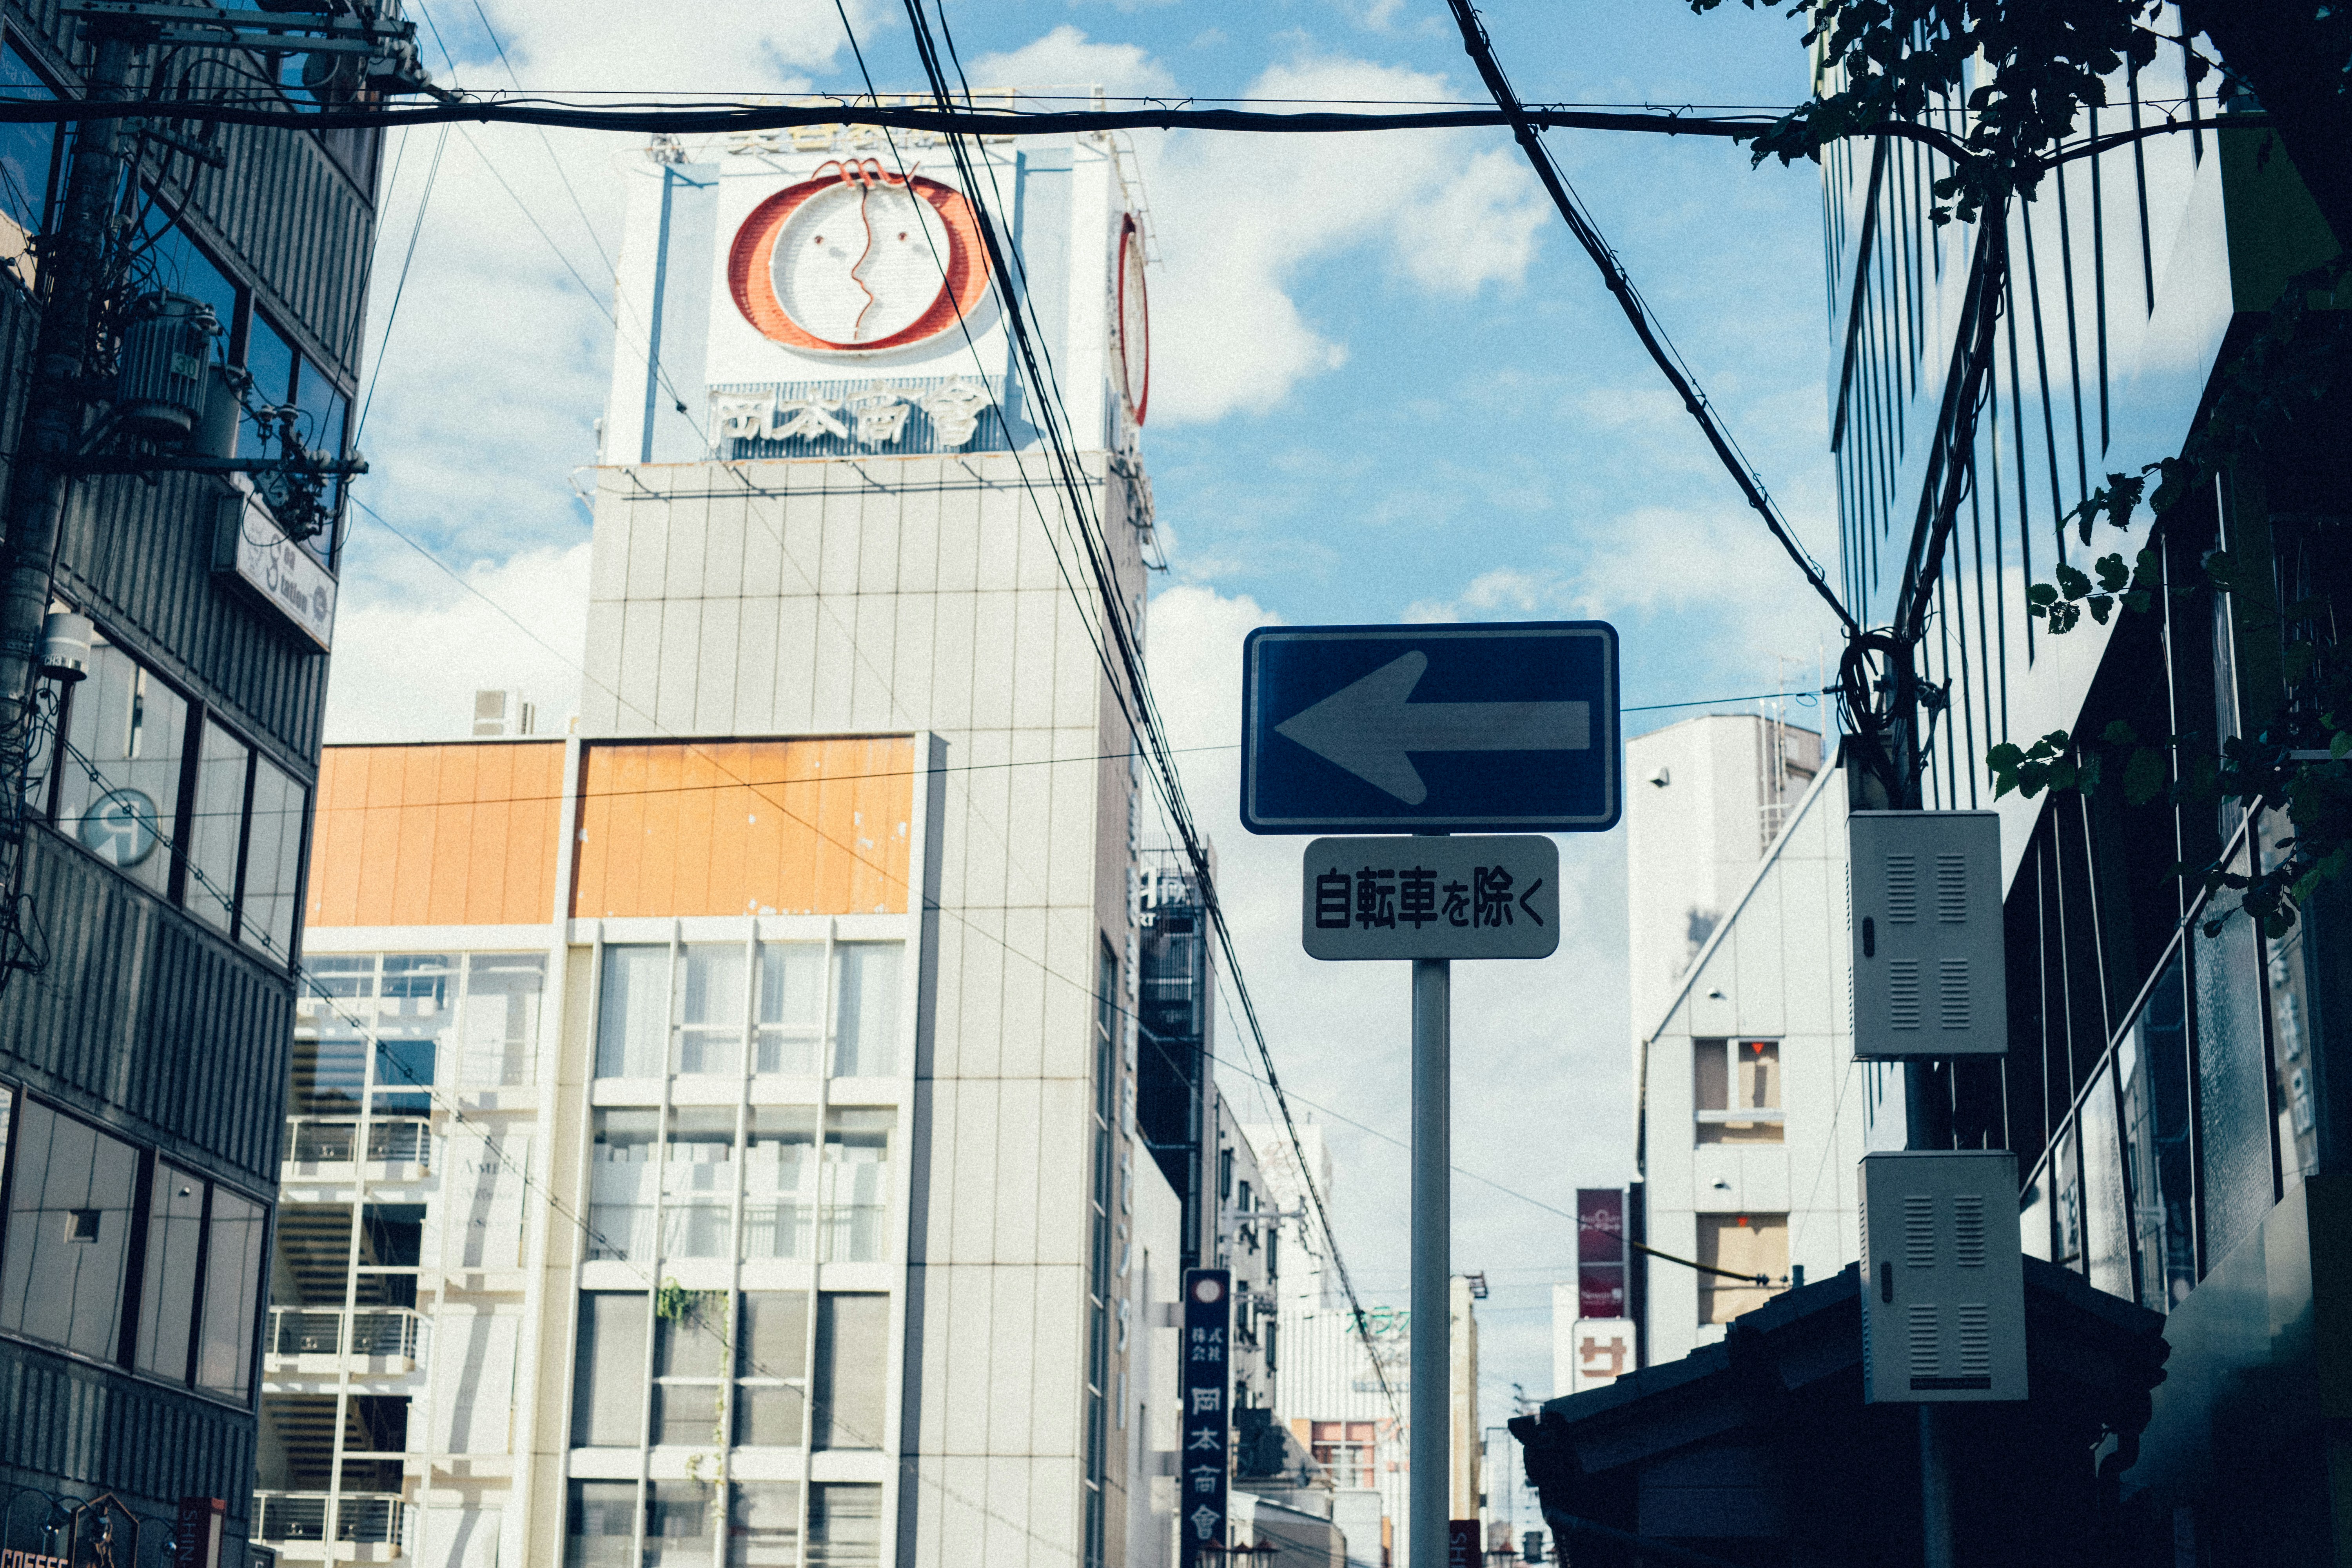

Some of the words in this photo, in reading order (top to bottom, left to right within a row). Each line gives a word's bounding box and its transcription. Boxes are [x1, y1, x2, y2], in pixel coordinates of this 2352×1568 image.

[175, 355, 196, 376] 30
[709, 375, 994, 448] 岡本商會
[1316, 865, 1543, 929] 自転車を除く
[1188, 1387, 1221, 1540] 岡本商會
[179, 1510, 197, 1568] SHIN
